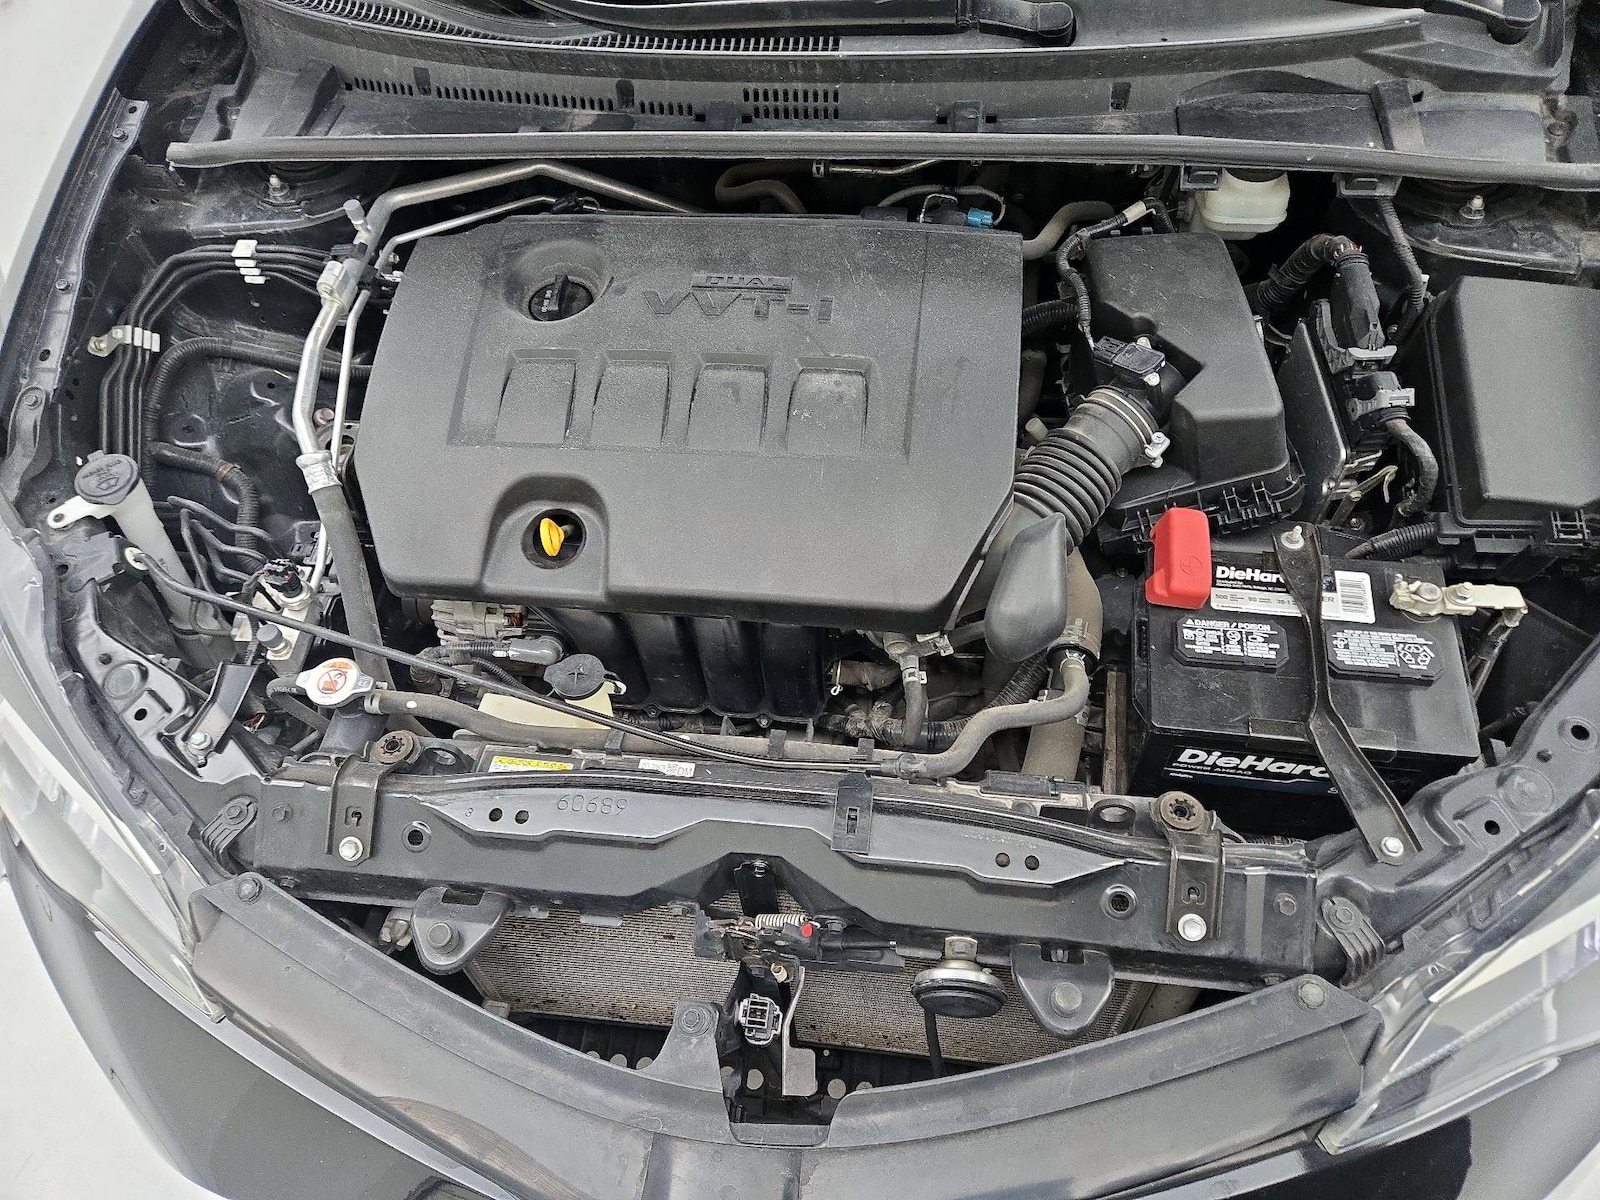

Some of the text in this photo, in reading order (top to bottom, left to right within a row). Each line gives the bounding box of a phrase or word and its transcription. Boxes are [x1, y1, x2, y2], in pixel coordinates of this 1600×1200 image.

[704, 275, 789, 289] DUAL
[1194, 619, 1230, 629] DANGER
[1238, 622, 1271, 631] POISON
[1172, 762, 1253, 775] POWER AHEAD
[557, 794, 628, 815] 60689
